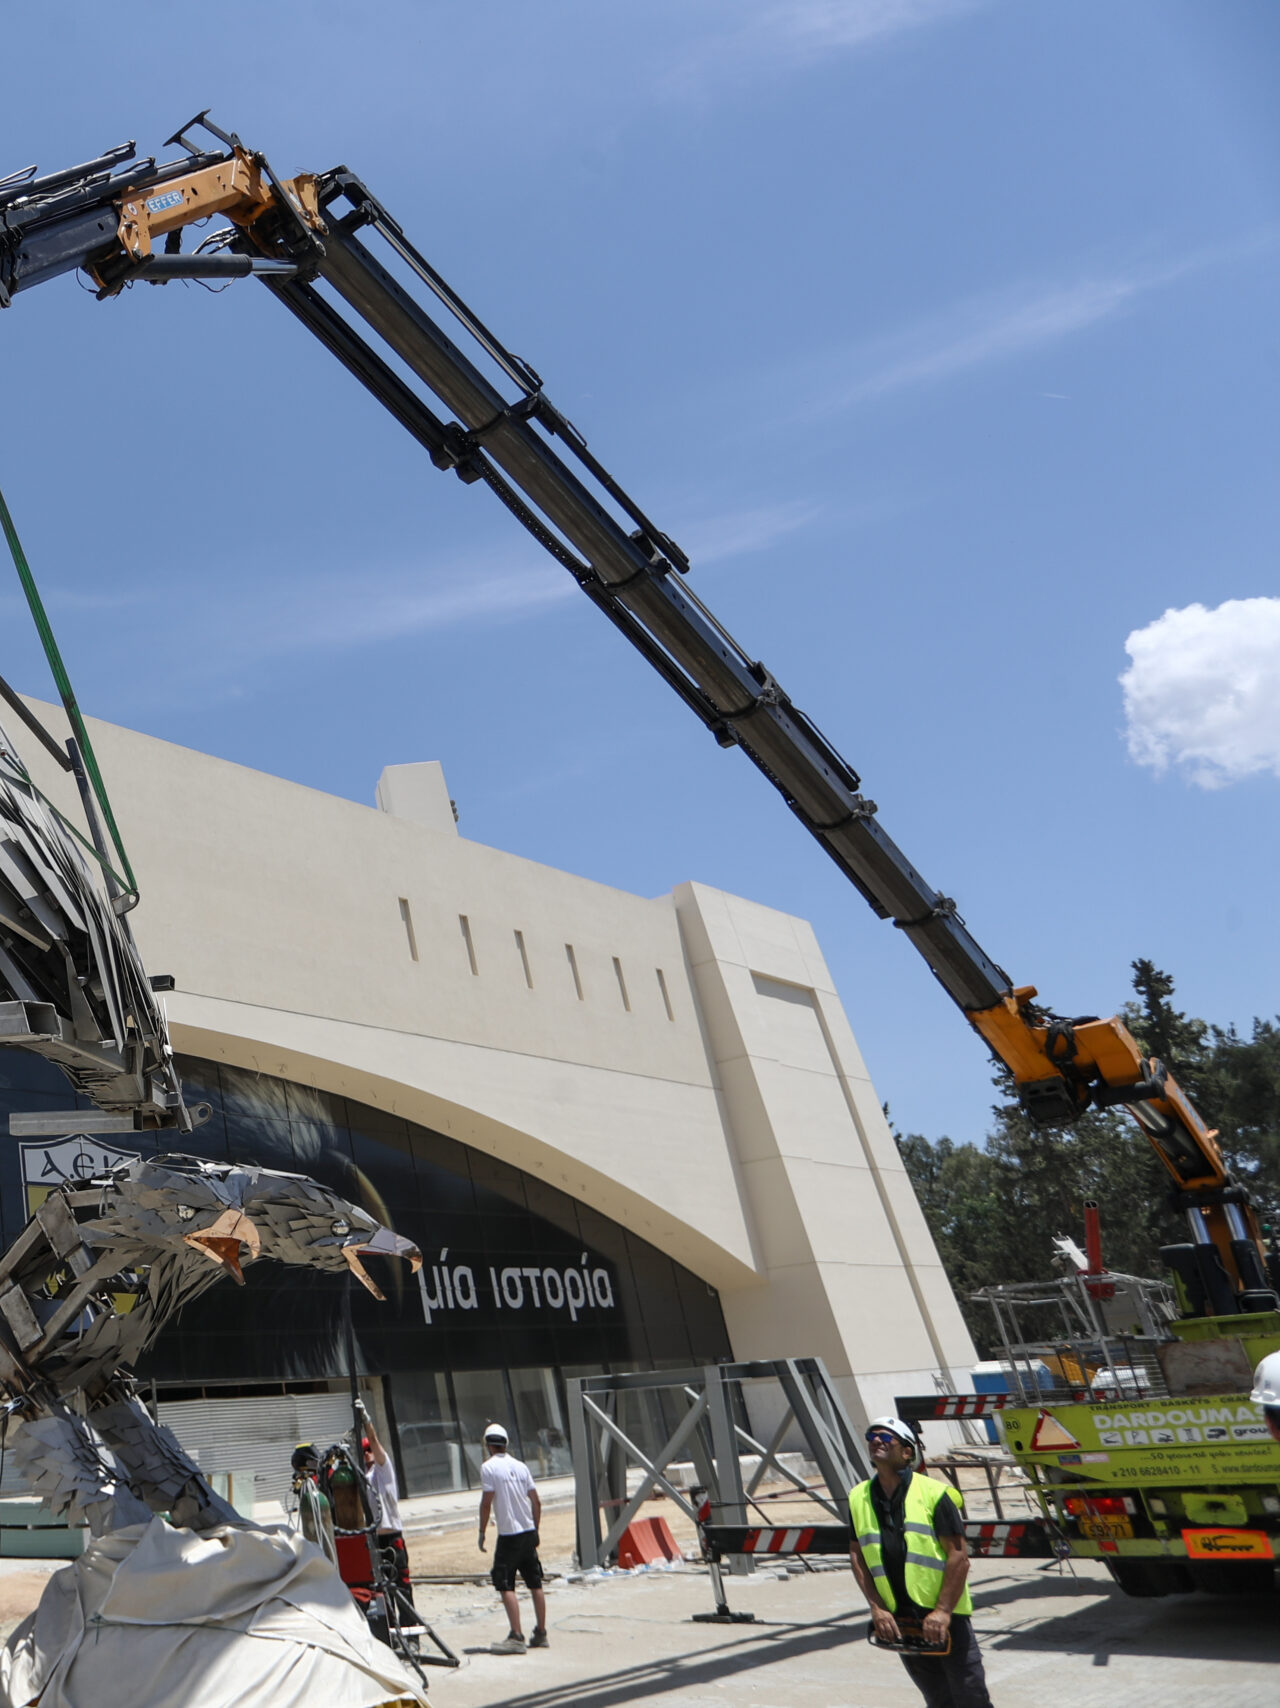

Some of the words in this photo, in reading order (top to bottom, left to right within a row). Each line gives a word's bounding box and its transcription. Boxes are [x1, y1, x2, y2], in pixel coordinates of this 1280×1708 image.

[148, 192, 182, 212] EFFER
[417, 1247, 479, 1325] μία
[489, 1251, 615, 1322] ιστορία
[1089, 1402, 1151, 1411] TRANSPORT
[1160, 1398, 1211, 1407] BASKETS
[1006, 1421, 1020, 1430] 80
[1233, 1427, 1270, 1438] grou
